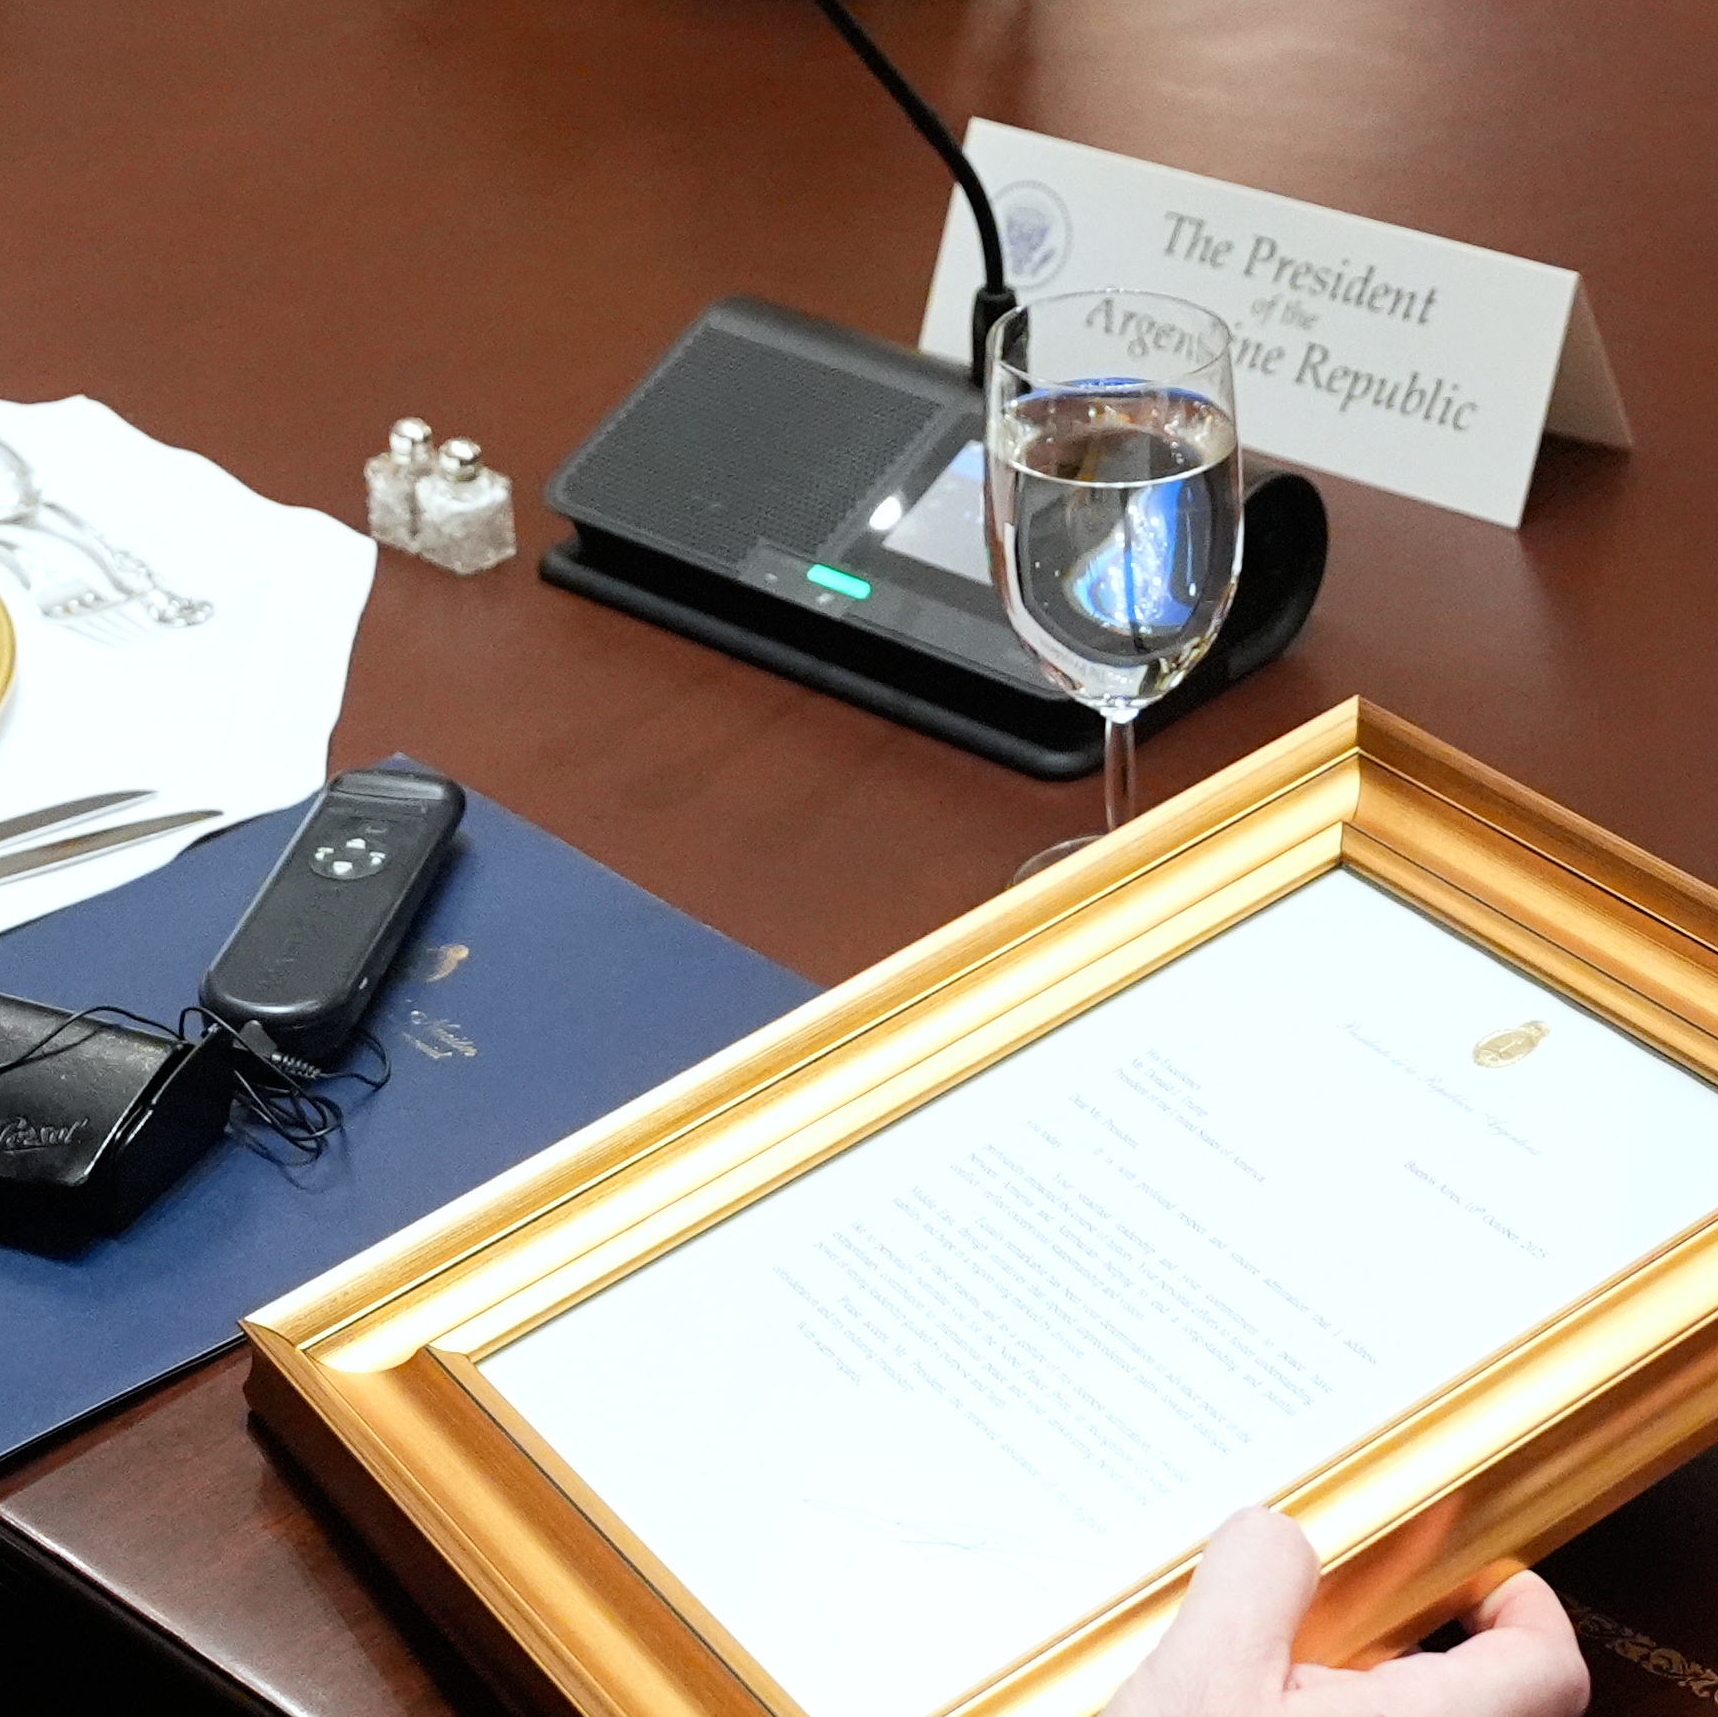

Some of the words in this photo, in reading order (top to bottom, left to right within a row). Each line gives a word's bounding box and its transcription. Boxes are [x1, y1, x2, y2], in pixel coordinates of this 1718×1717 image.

[1164, 210, 1234, 268] The
[1242, 234, 1438, 325] President
[1249, 293, 1281, 326] of
[1282, 299, 1321, 331] the
[1294, 341, 1480, 432] Republic
